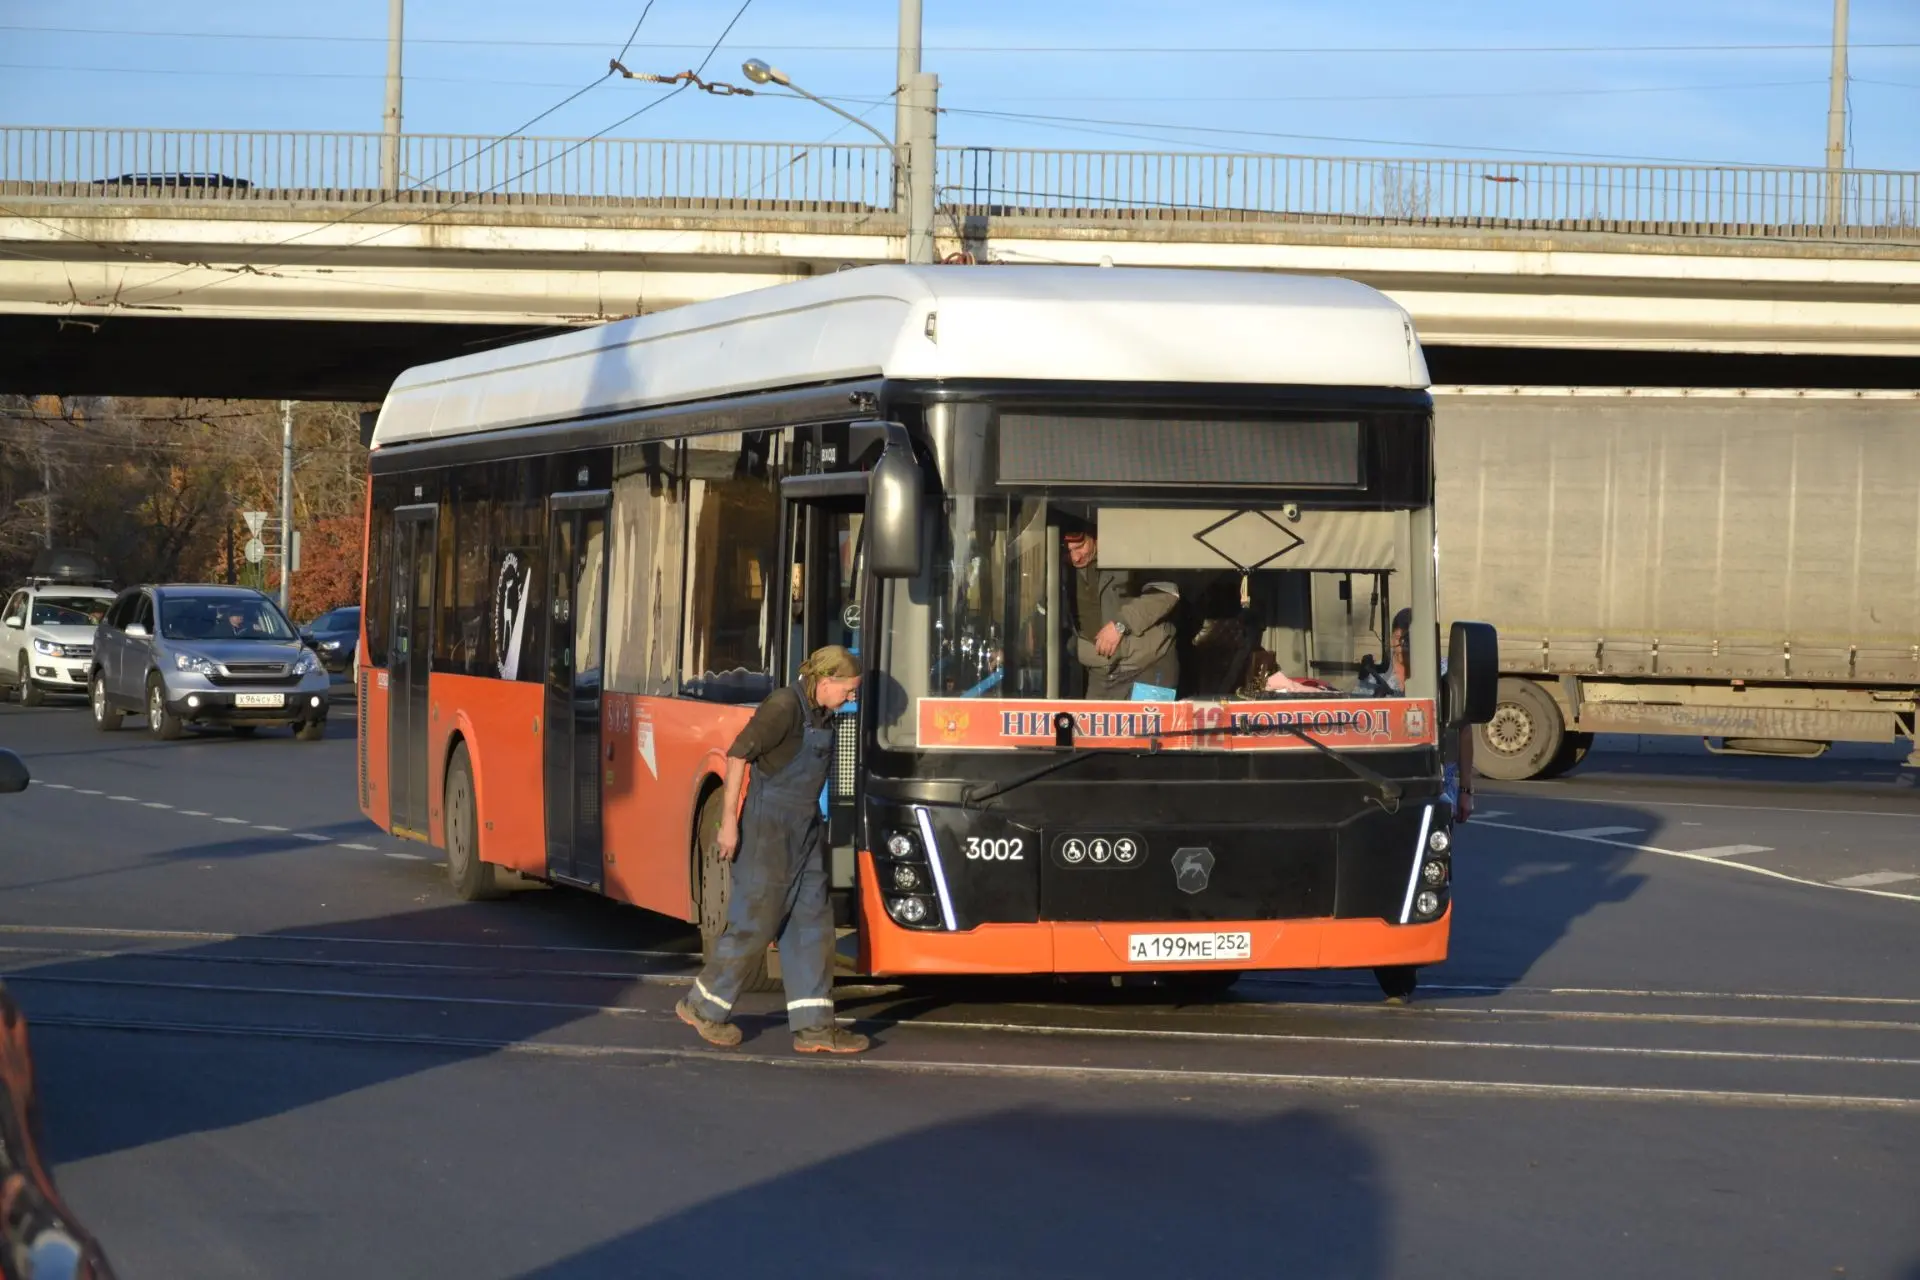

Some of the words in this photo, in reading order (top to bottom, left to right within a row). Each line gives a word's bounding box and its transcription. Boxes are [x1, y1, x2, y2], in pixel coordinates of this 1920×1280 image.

[1192, 706, 1225, 747] 12
[1230, 709, 1392, 741] НОВГОРОД
[966, 837, 1024, 861] 3002
[1137, 936, 1212, 957] А199МЕ
[1217, 934, 1245, 950] 252
